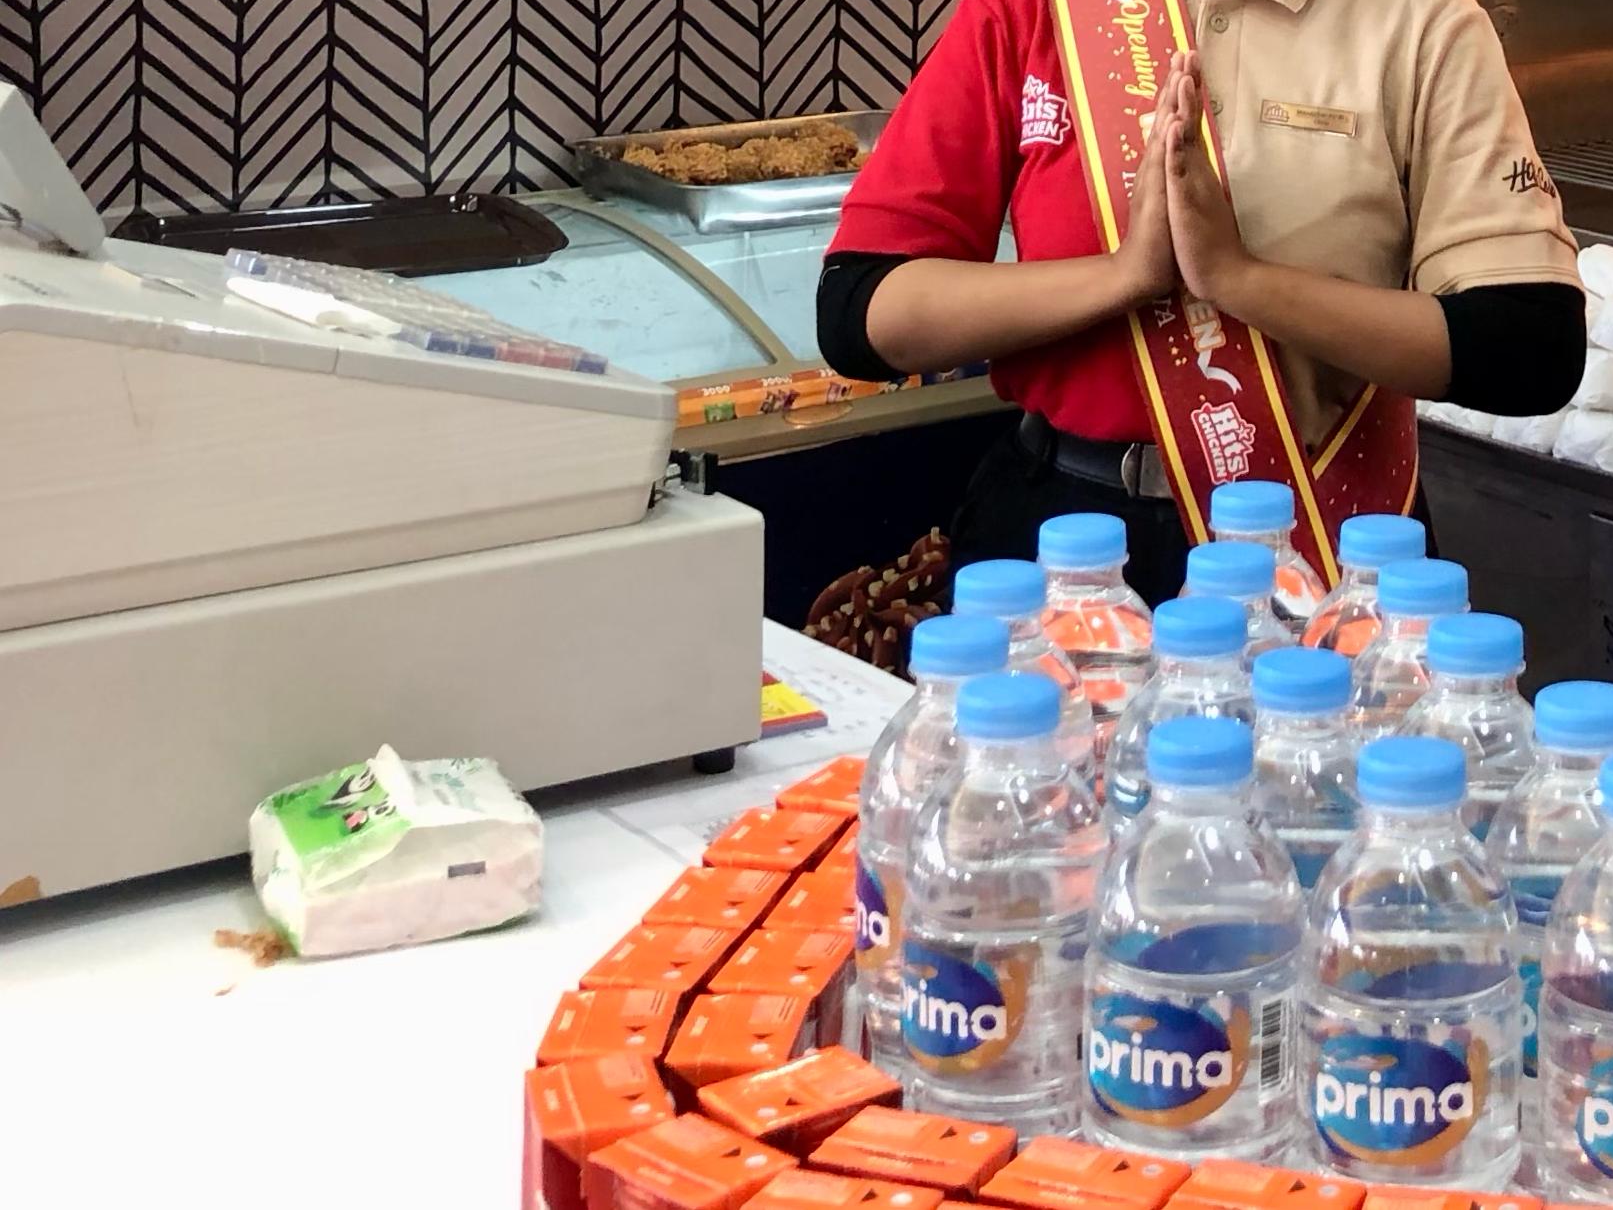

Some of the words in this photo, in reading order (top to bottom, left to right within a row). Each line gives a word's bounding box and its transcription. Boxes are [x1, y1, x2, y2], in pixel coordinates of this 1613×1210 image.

[1198, 412, 1228, 478] CHICKEN
[902, 978, 1008, 1041] rima
[1089, 1028, 1233, 1089] prima
[1316, 1070, 1474, 1125] prima
